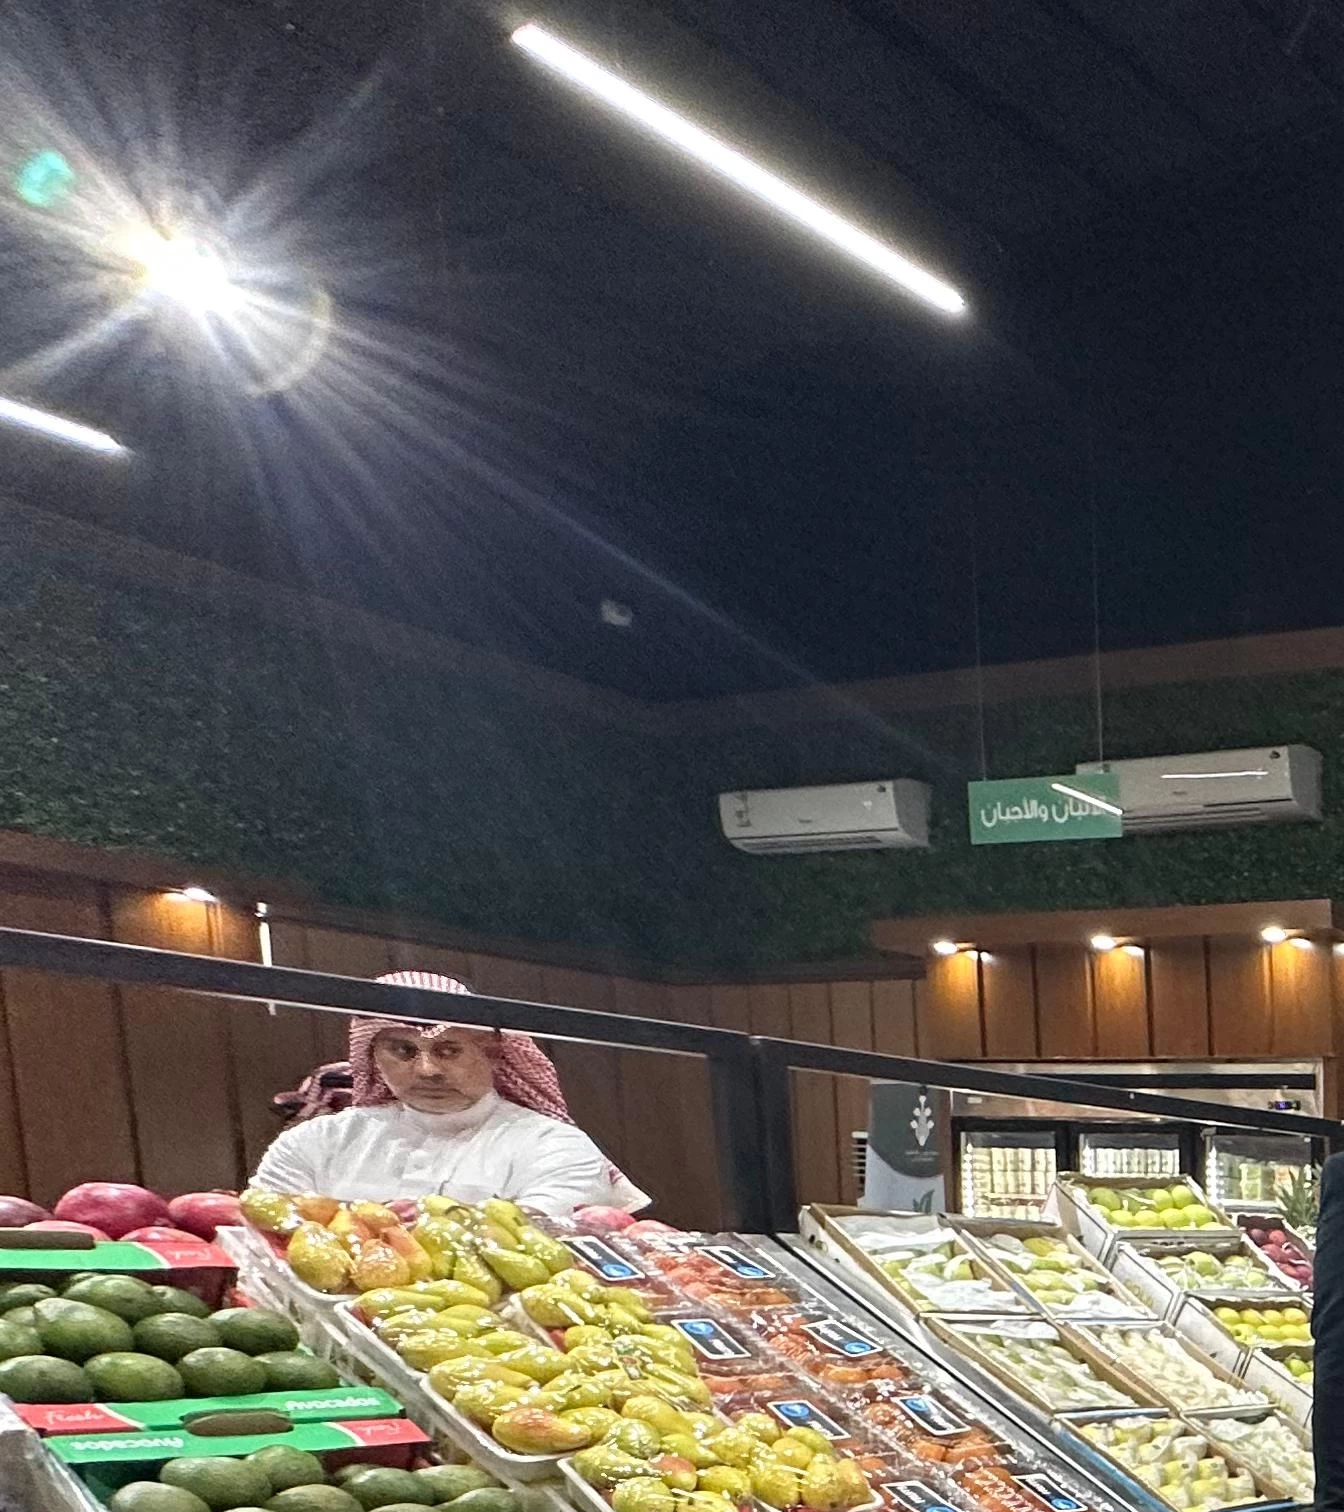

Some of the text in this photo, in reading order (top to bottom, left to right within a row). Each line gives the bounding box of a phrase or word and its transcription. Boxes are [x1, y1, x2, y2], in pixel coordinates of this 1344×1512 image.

[285, 1395, 382, 1412] Avocados
[44, 1408, 105, 1426] Fresh
[70, 1435, 185, 1451] Avocados
